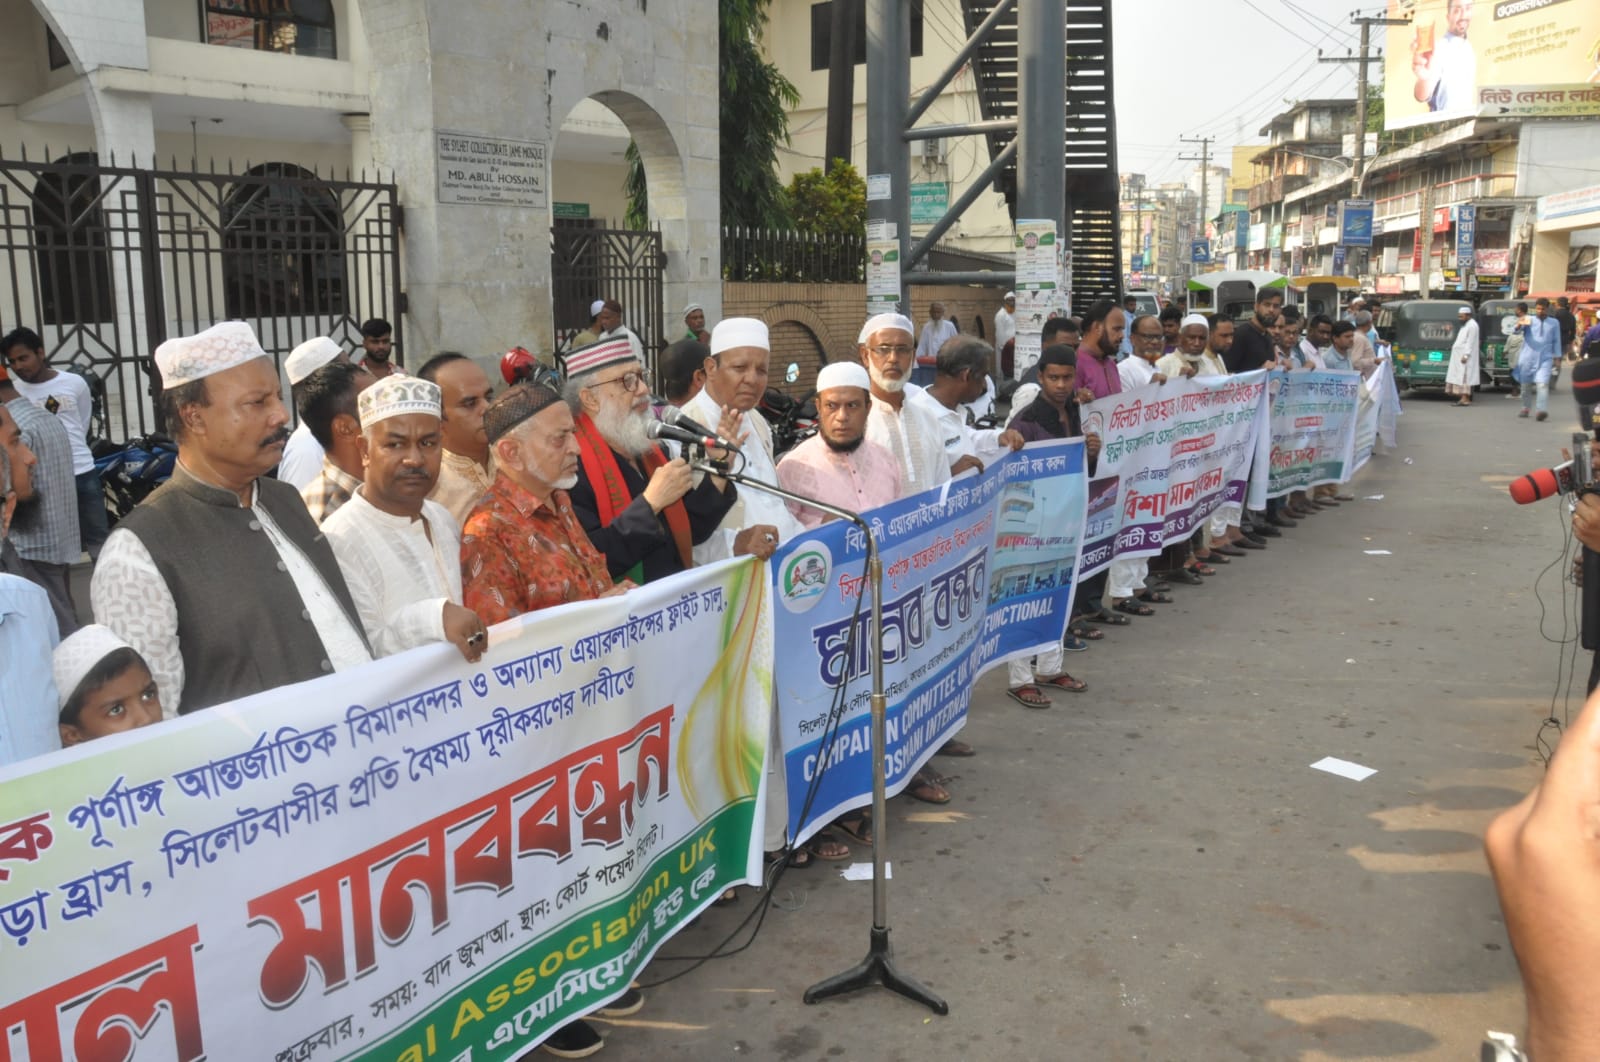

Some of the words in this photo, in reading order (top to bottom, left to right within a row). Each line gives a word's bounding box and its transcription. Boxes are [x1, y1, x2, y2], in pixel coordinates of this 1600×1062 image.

[448, 170, 467, 180] MD.
[469, 172, 494, 183] ABUL
[498, 173, 539, 186] HOSSAIN
[1121, 489, 1169, 525] বিশা
[68, 776, 166, 848] পূর্ণাঙ্গ
[173, 723, 337, 800] আন্তর্জাতিক
[345, 680, 462, 749] বিমানবন্দর
[470, 671, 488, 698] ও
[492, 645, 564, 689] অন্যান্য
[570, 609, 663, 665] এয়ারলাইন্সের
[666, 591, 699, 632] ফ্লাইট
[161, 783, 340, 880] সিলেটবাসীর
[349, 756, 401, 809] প্রতি
[402, 731, 472, 782] বৈষম্য
[476, 687, 576, 758] দূরীকরণের
[580, 666, 636, 708] দাবীতে
[803, 717, 899, 784] CAMPAIN
[902, 675, 957, 736] COMMITTEE
[957, 657, 969, 686] UK
[983, 596, 1054, 636] FUNCTIONAL
[925, 685, 971, 741] INTERNAT
[0, 923, 206, 1062] াল
[246, 703, 676, 1011] মানববন্ধন
[370, 979, 418, 1020] সময়:
[422, 953, 454, 989] বাদ
[556, 864, 591, 911] কোর্ট
[594, 846, 635, 888] পয়েন্ট
[450, 870, 670, 1041] Association
[679, 826, 717, 875] UK
[485, 920, 650, 1051] এসোসিয়েশন
[653, 885, 685, 930] ইউ
[689, 863, 717, 901] কে
